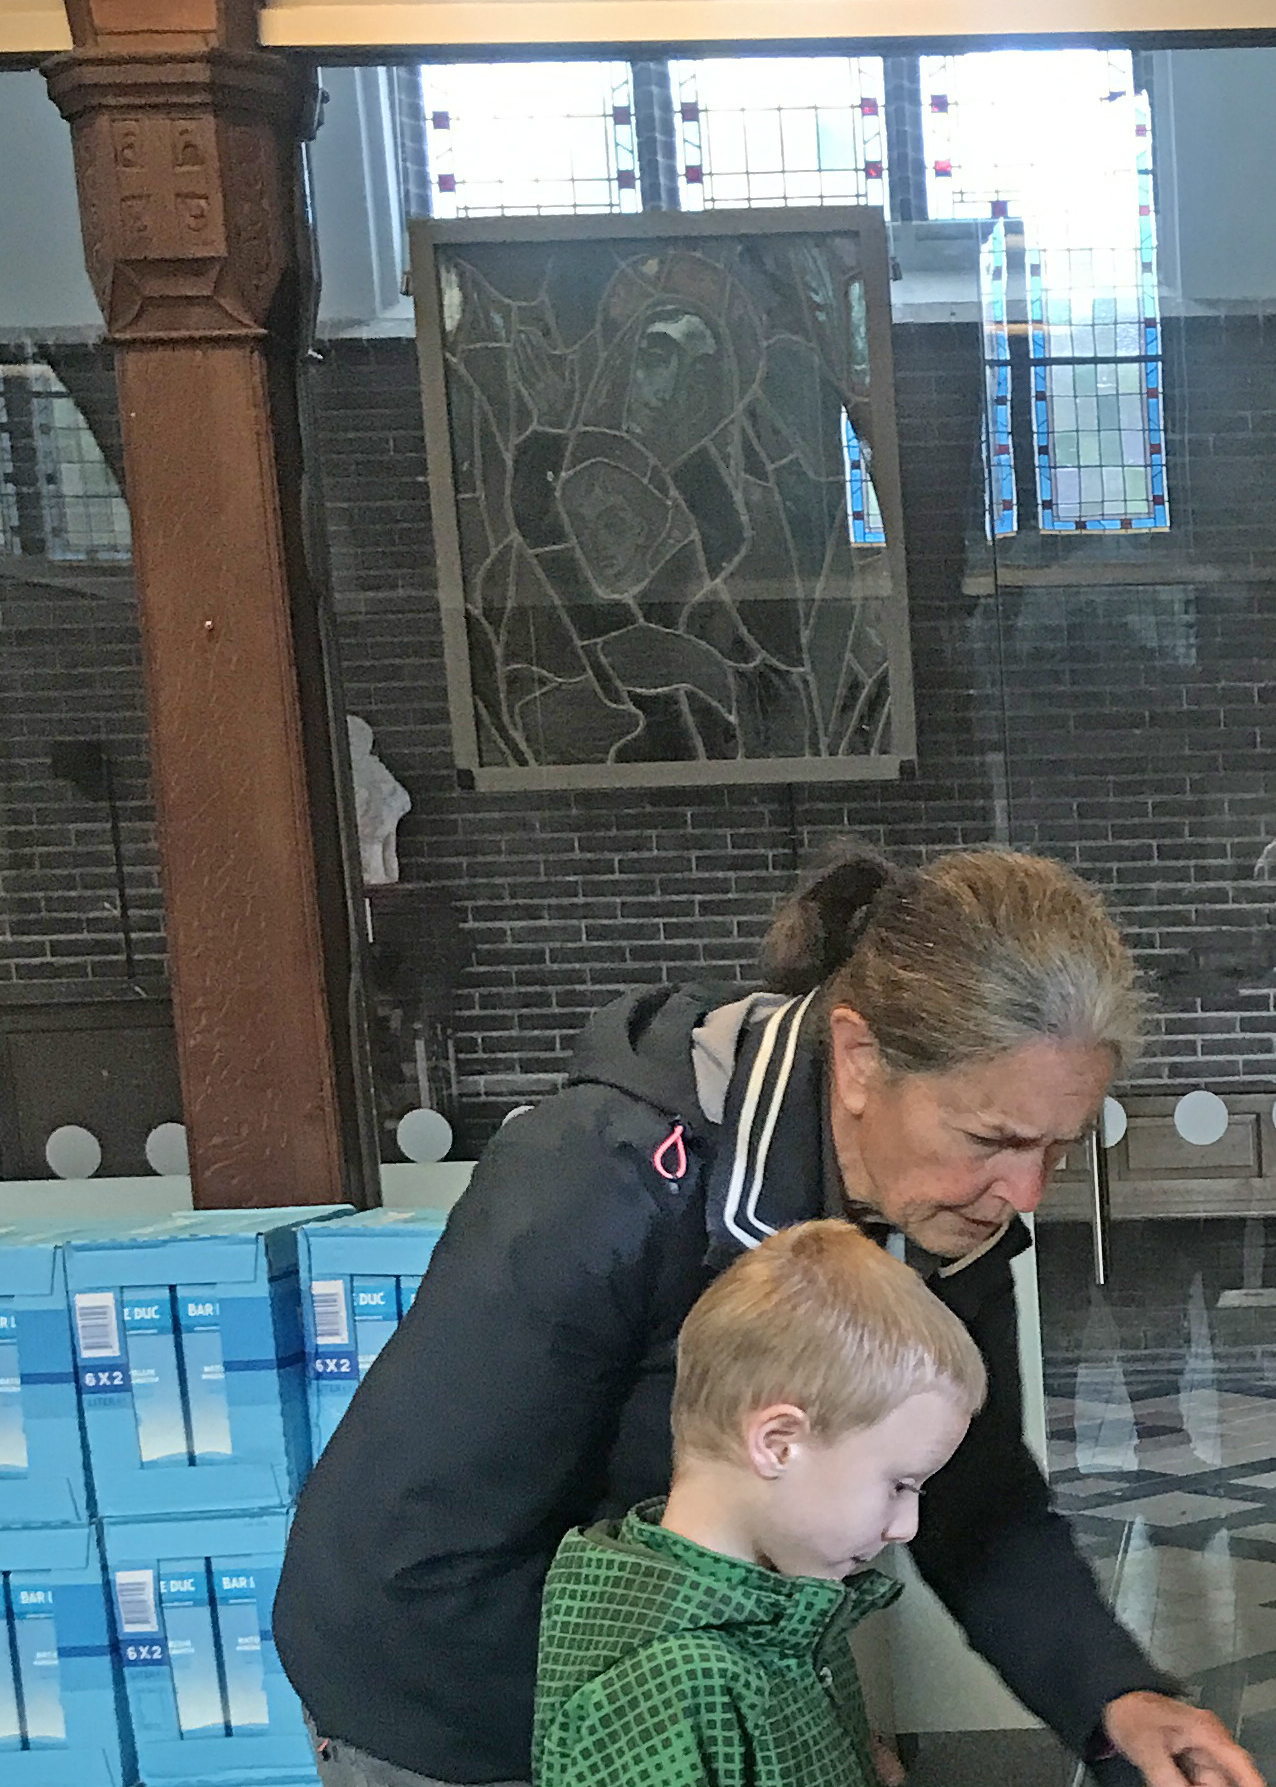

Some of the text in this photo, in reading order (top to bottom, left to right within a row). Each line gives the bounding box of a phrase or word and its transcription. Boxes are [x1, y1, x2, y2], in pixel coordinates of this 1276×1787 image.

[358, 1292, 386, 1305] DUC
[134, 1305, 160, 1319] DUC
[188, 1302, 214, 1317] BAR
[170, 1578, 196, 1592] DUC
[222, 1576, 247, 1590] BAR
[20, 1591, 45, 1604] BAR
